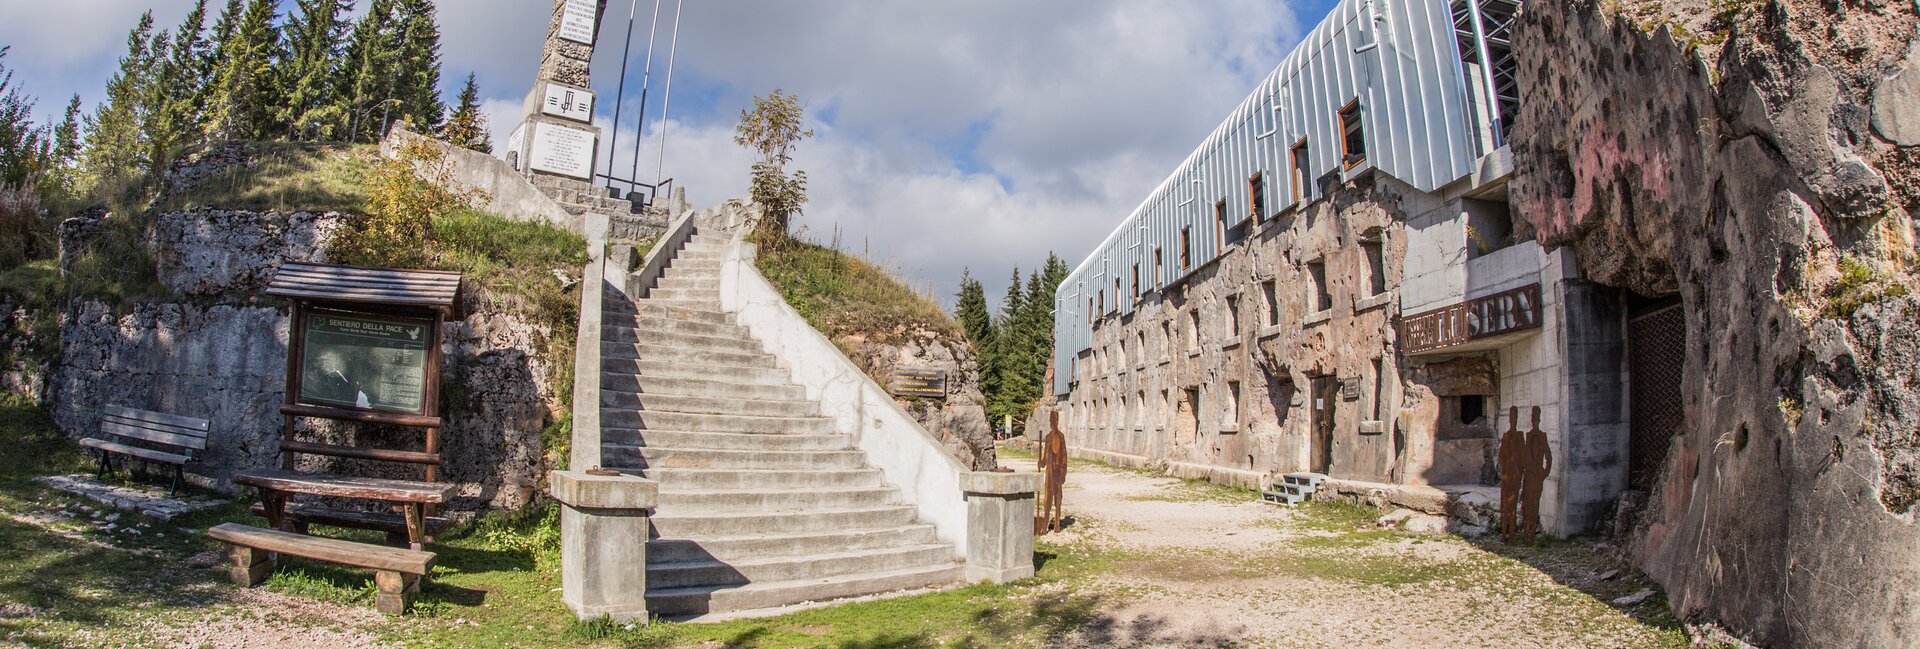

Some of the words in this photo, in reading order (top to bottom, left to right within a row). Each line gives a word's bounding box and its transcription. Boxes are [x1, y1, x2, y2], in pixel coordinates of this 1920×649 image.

[329, 319, 360, 329] SENTIERO
[363, 322, 383, 331] DELLA
[386, 325, 403, 333] PACE
[1437, 288, 1534, 342] LUSERN
